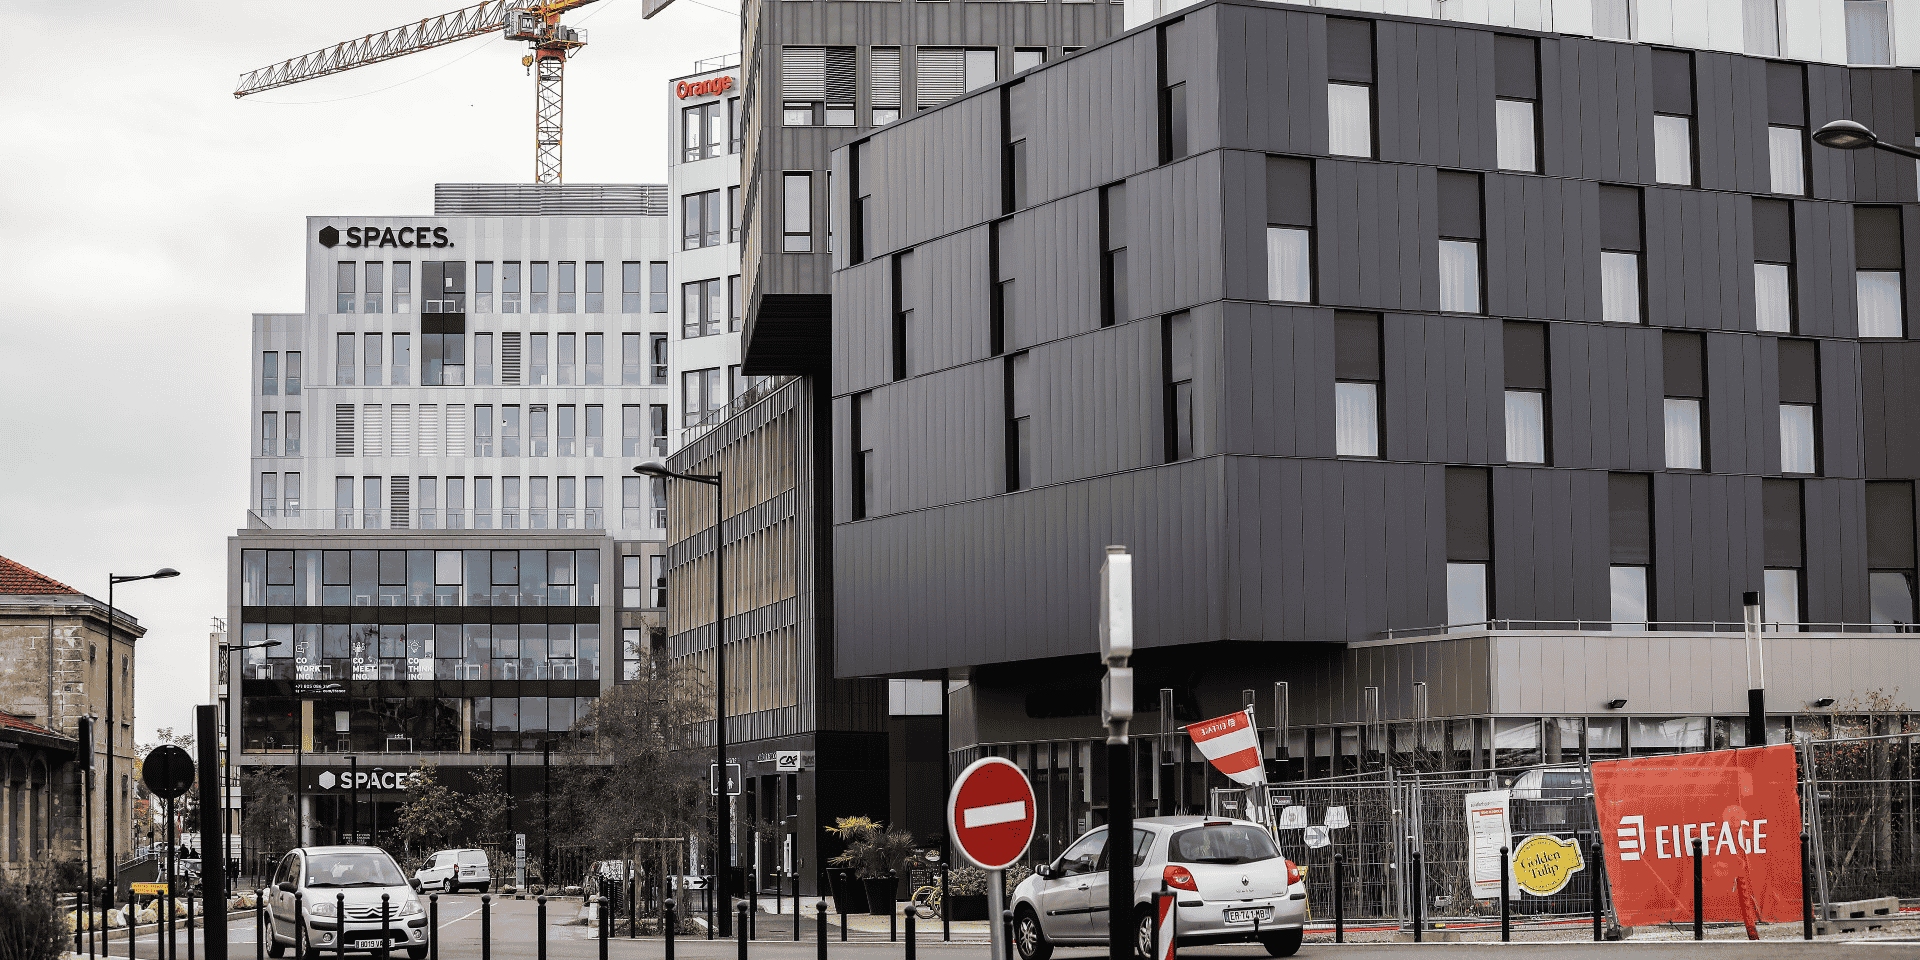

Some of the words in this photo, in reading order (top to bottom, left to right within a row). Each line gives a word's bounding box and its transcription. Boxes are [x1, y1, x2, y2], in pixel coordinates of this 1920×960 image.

[677, 76, 732, 99] Orange
[346, 226, 454, 248] SPACES.
[1655, 819, 1768, 859] EIFFAGE
[1520, 850, 1562, 871] Golden
[1528, 863, 1560, 879] Tulip
